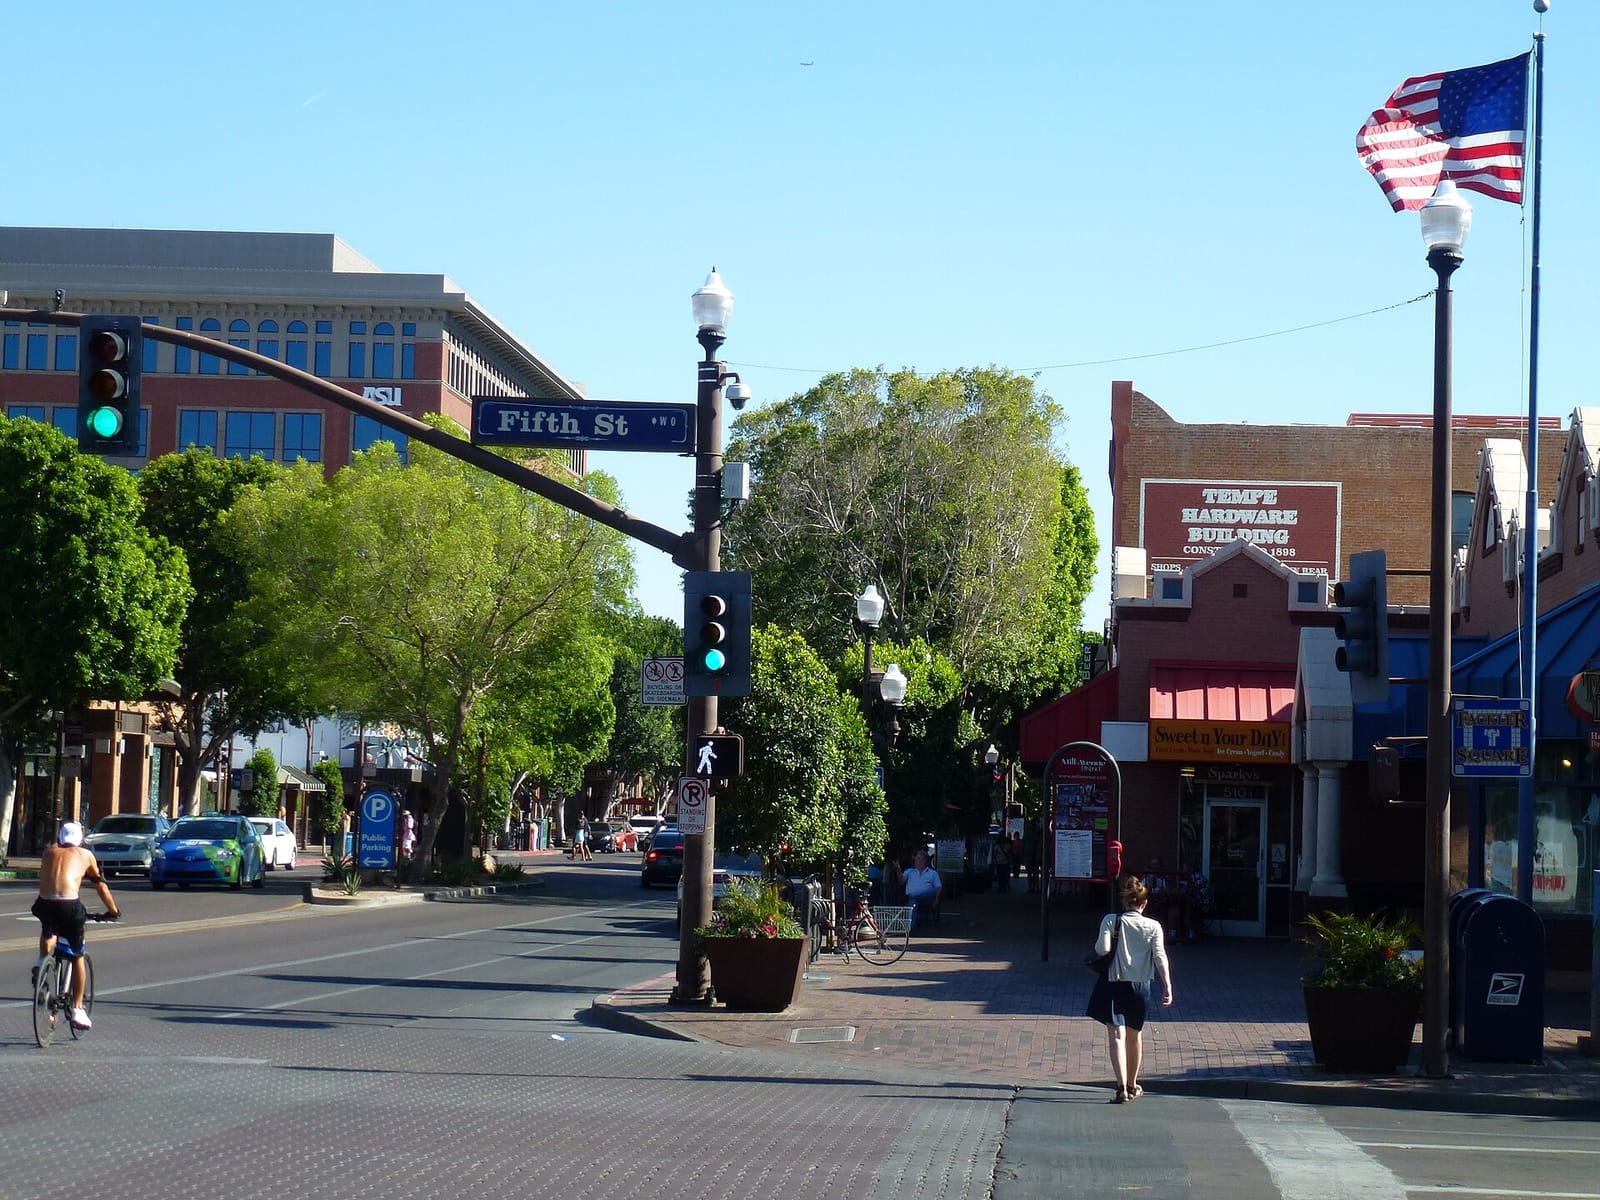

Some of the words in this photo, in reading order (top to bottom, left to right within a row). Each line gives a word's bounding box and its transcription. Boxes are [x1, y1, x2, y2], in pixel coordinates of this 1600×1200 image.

[363, 386, 402, 406] ASU
[498, 410, 580, 434] Fifth
[594, 413, 629, 436] St
[1202, 488, 1278, 505] TEMPE
[1181, 508, 1298, 525] HARDWARE
[1188, 528, 1290, 545] BUILDING
[1271, 548, 1296, 557] 1898
[1082, 646, 1091, 680] BEER
[1456, 711, 1528, 728] FACKLER
[1156, 726, 1199, 745] Sweet
[1200, 732, 1209, 745] n
[1213, 728, 1247, 746] Your
[1456, 746, 1528, 765] SQUARE
[1208, 767, 1260, 780] Sparky's
[371, 798, 386, 818] P
[361, 834, 387, 842] Public
[361, 844, 392, 853] Parking
